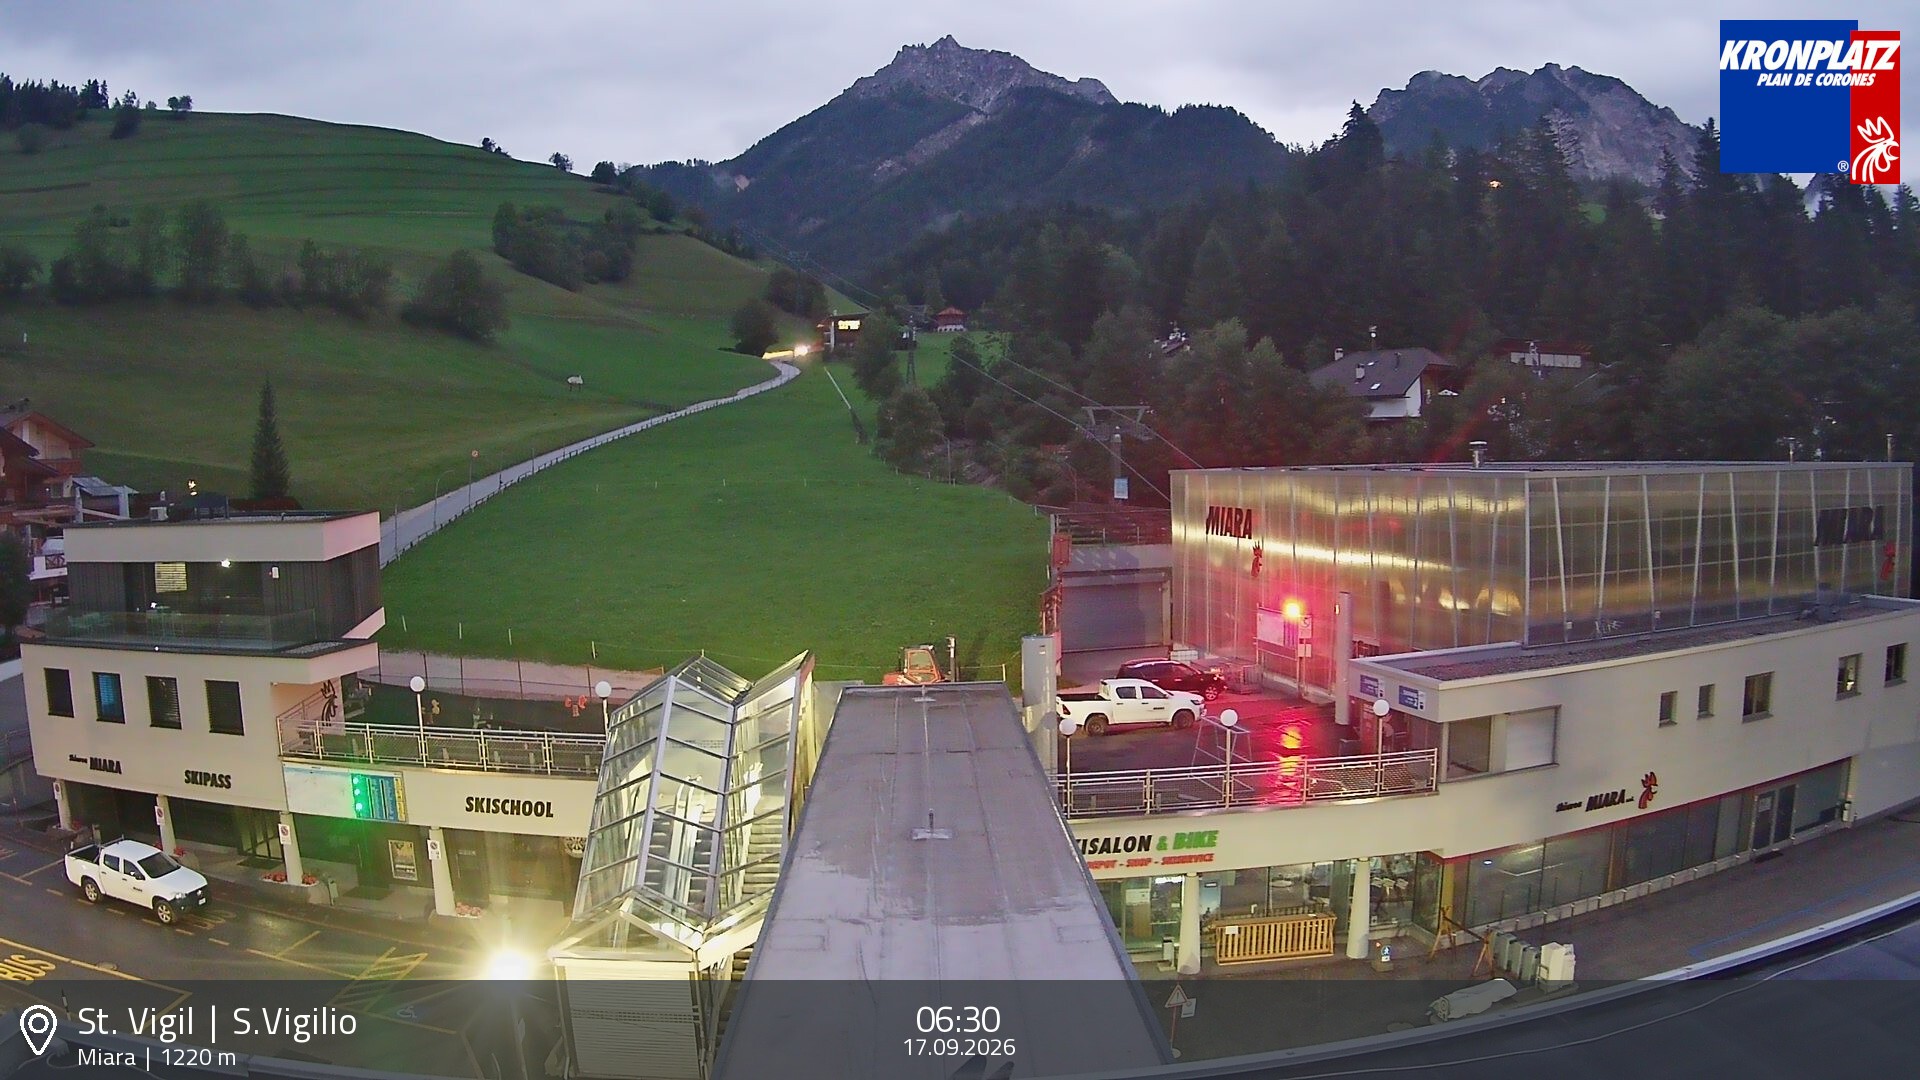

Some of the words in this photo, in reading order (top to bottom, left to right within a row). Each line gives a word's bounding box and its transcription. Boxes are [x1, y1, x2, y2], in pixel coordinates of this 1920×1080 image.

[1206, 505, 1252, 539] MIARA
[90, 757, 122, 774] MIARA
[184, 770, 232, 789] SKIPASS
[465, 796, 554, 818] SKISCHOOL
[1585, 789, 1625, 812] MIARA
[1076, 835, 1152, 854] ISALON
[1156, 836, 1168, 851] &
[1173, 830, 1219, 850] BIKE
